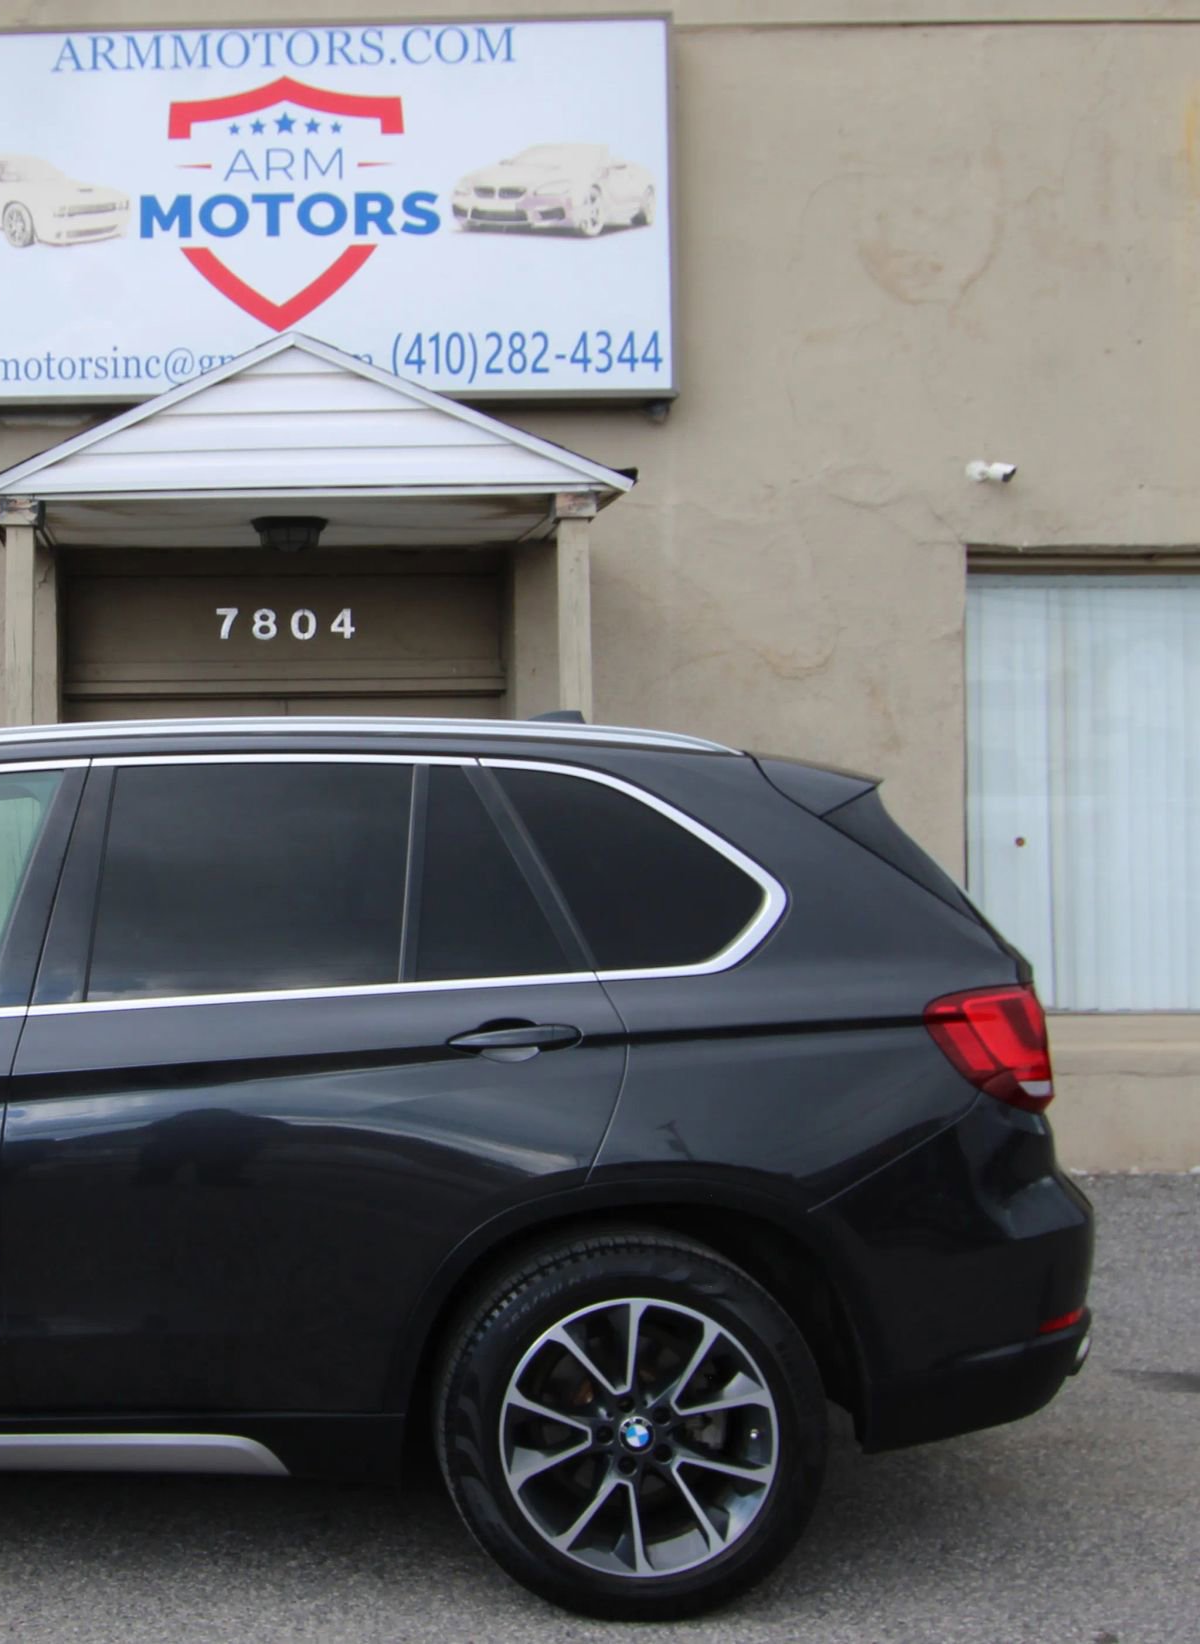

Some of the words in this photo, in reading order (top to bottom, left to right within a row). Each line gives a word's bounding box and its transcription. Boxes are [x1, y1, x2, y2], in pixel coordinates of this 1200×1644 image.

[51, 25, 516, 72] ARMMOTORS.COM
[223, 147, 344, 181] ARM
[139, 190, 441, 239] MOTORS
[391, 330, 664, 384] (410)282-4344
[215, 607, 356, 641] 7804
